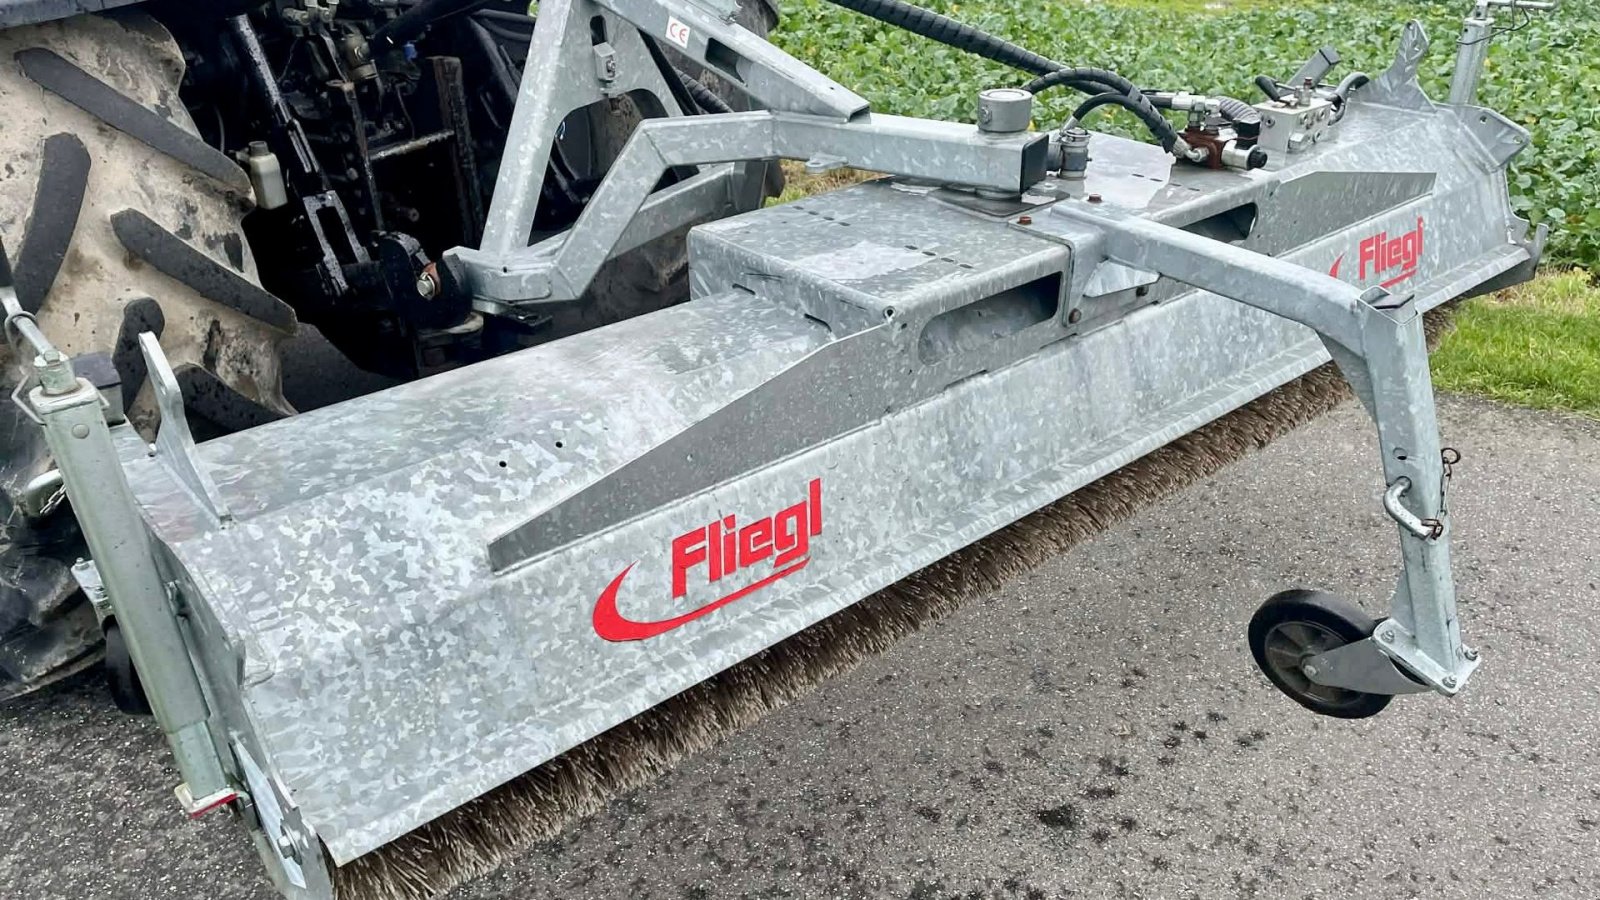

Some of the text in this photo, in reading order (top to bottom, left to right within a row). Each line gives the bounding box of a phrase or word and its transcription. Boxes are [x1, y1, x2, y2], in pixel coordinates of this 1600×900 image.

[669, 22, 688, 44] CE
[1359, 216, 1424, 281] Fliegl
[672, 478, 822, 599] Fliegl
